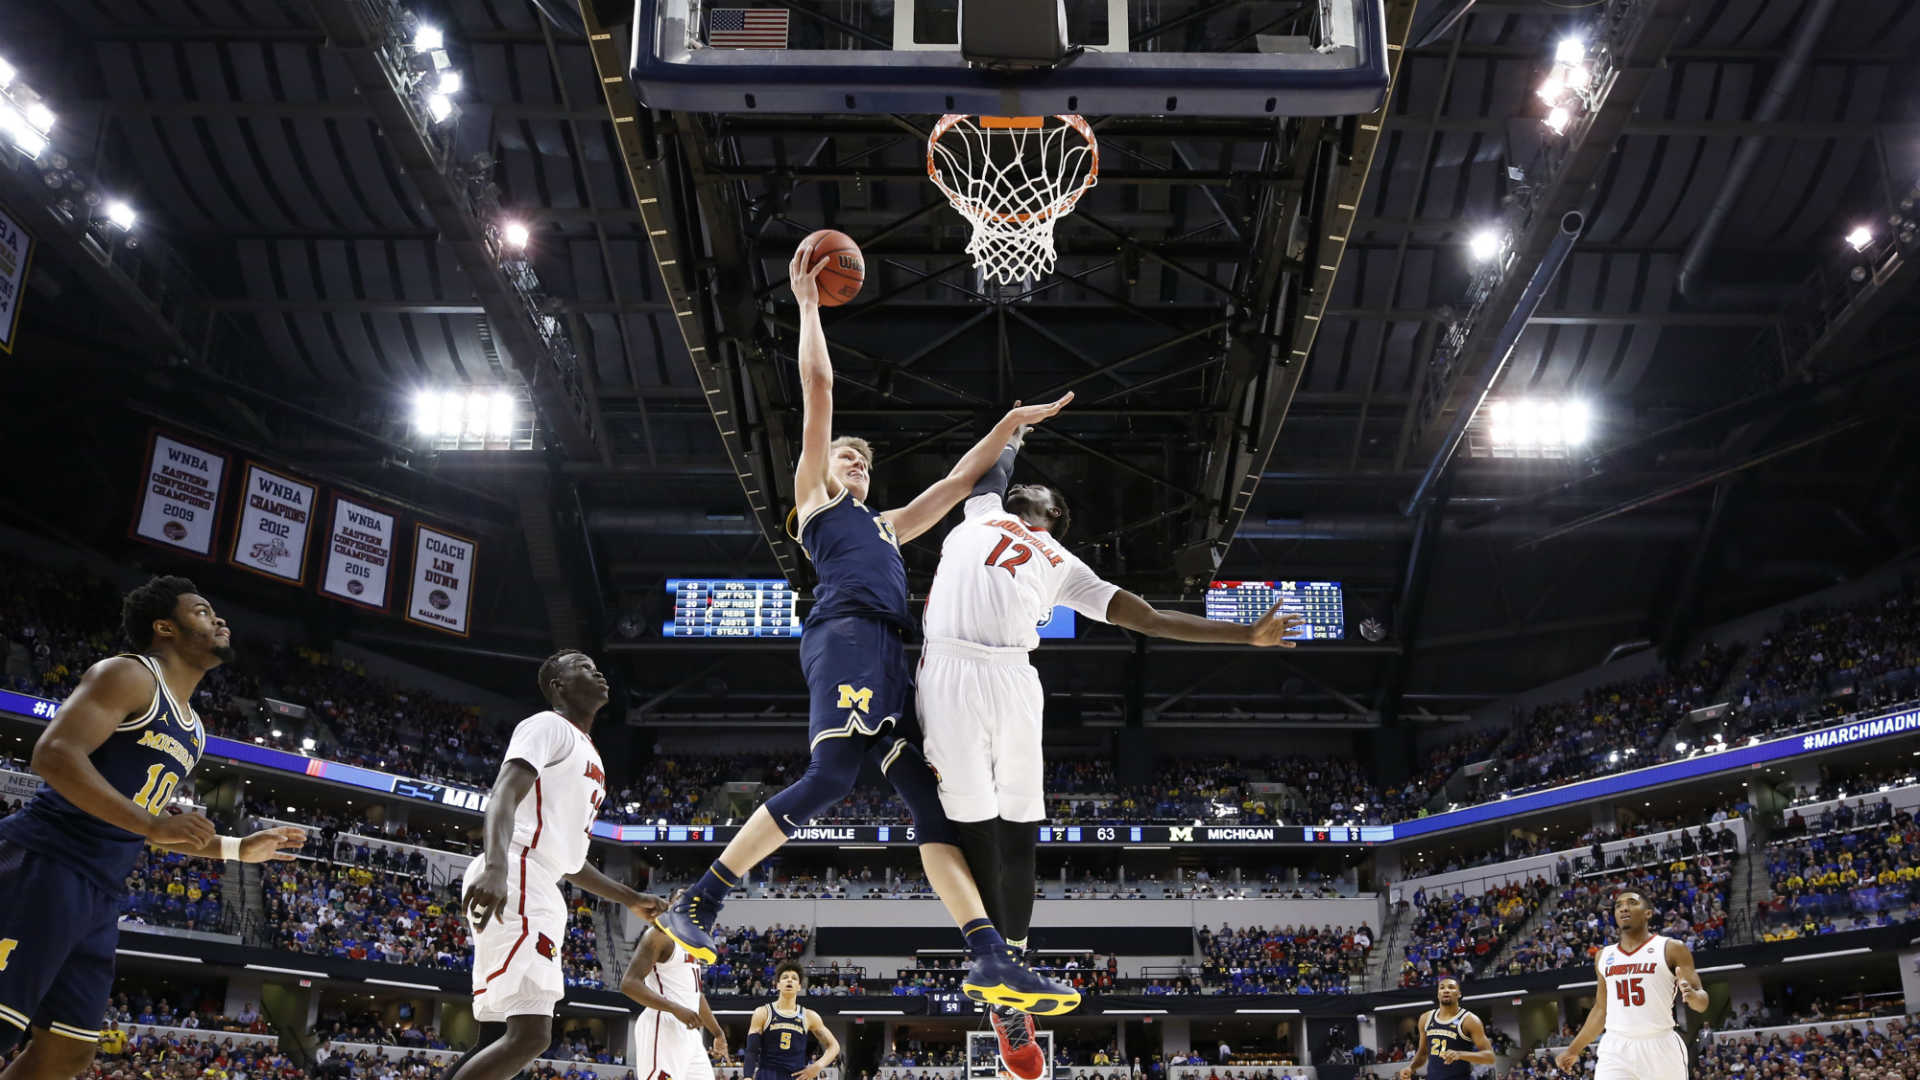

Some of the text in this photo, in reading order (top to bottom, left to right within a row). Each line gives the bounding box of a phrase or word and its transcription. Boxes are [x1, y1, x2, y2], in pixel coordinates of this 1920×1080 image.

[168, 447, 208, 472] WNBA
[162, 465, 208, 488] EASTERN
[152, 473, 216, 501] CONFERENCE
[259, 477, 302, 505] WNBA
[152, 484, 211, 510] CHAMPIONS
[163, 503, 195, 522] 2009
[250, 494, 306, 524] CHAMPIONS
[259, 518, 290, 539] 2012
[347, 510, 382, 532] WNBA
[334, 533, 388, 558] CONFERENCE
[342, 526, 383, 546] EASTERN
[334, 544, 385, 567] CHAMPIONS
[426, 537, 466, 560] COACH
[984, 533, 1033, 579] 12
[345, 562, 371, 578] 2015
[433, 557, 455, 574] LIN
[424, 569, 460, 590] DUNN
[1281, 581, 1296, 590] M
[716, 628, 750, 636] STEALS
[837, 684, 873, 714] M
[133, 763, 179, 816] 10
[692, 831, 699, 840] 5
[790, 828, 855, 840] UISVILLE
[906, 828, 915, 840] 5
[1055, 832, 1063, 840] 2
[1097, 827, 1115, 841] 63
[1169, 826, 1194, 842] M
[1208, 828, 1274, 840] MICHIGAN
[1352, 831, 1359, 840] 3
[1605, 962, 1657, 977] LOUISVILLE
[934, 993, 940, 1002] U
[953, 993, 959, 1001] L
[1616, 977, 1646, 1007] 45
[780, 1031, 792, 1050] 5
[1430, 1037, 1447, 1056] 21
